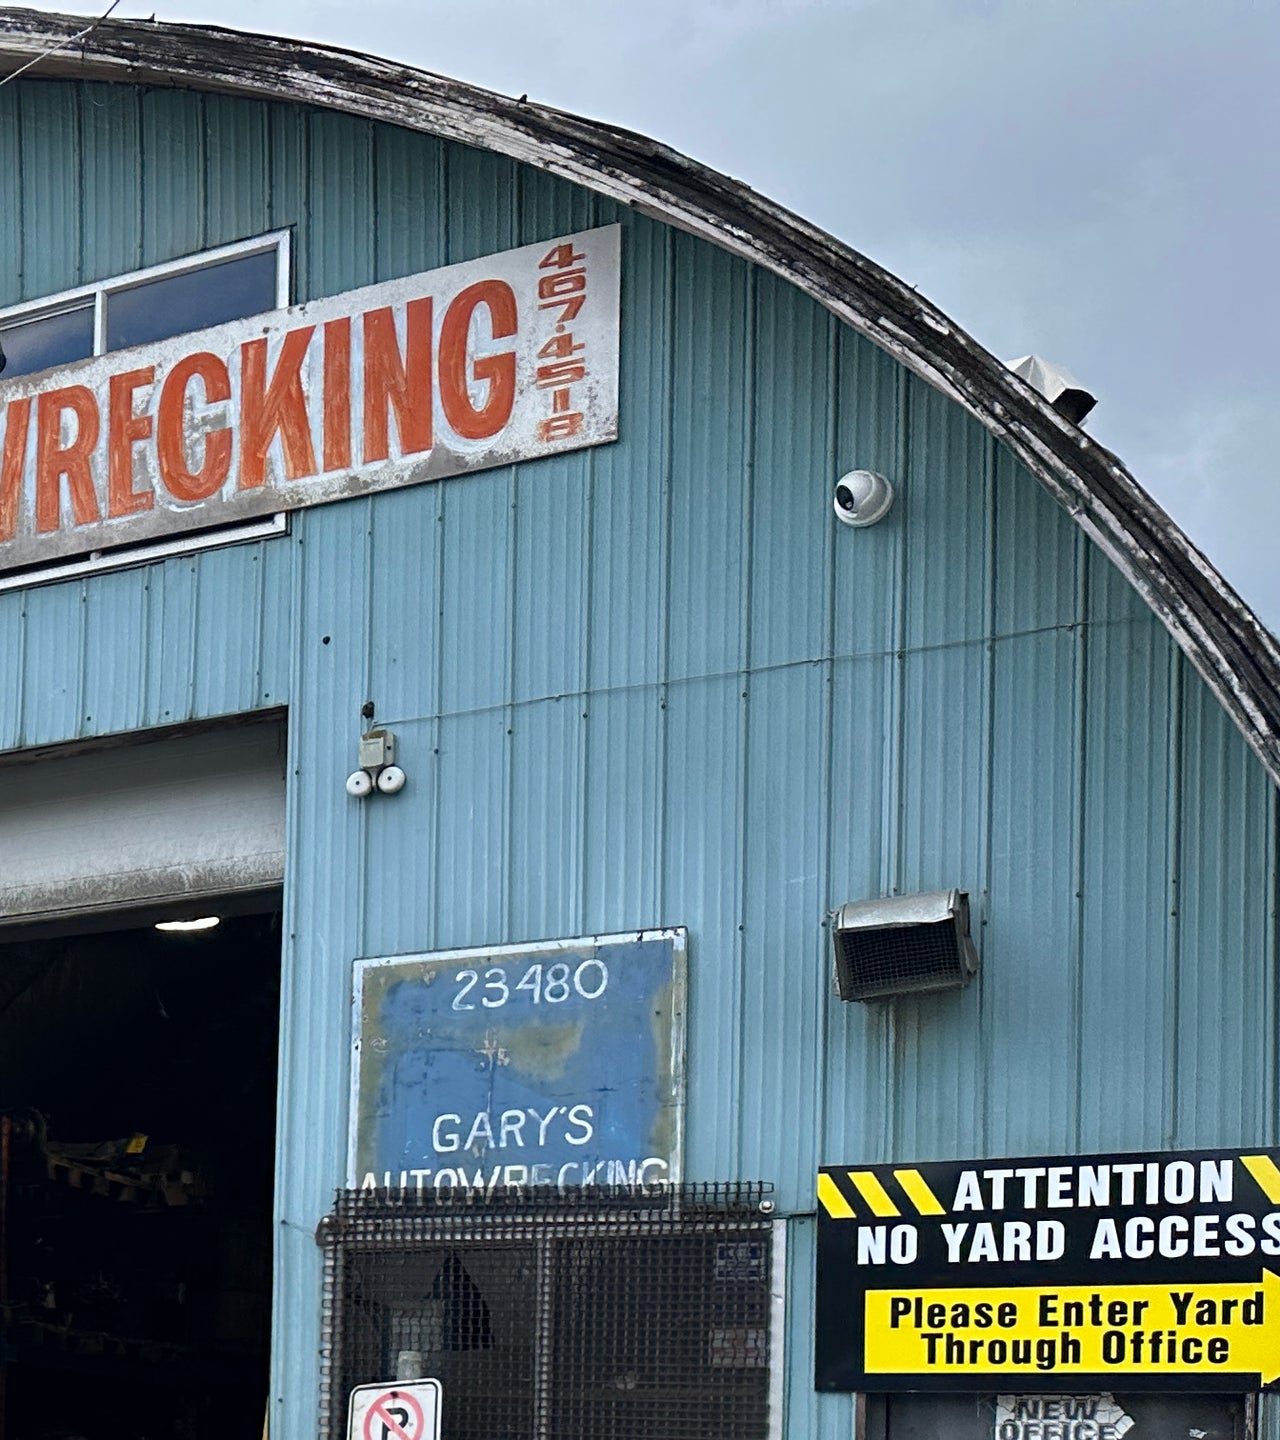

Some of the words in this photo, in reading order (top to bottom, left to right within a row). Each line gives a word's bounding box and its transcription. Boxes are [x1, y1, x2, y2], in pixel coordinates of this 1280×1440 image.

[451, 958, 609, 1011] 23480
[431, 1104, 594, 1153] GARY'S
[951, 1160, 1234, 1212] ATTENTION
[856, 1224, 919, 1266] NO
[940, 1220, 1066, 1264] YARD
[1089, 1212, 1280, 1260] ACCESS
[890, 1296, 1018, 1329] Please
[1039, 1294, 1150, 1328] Enter
[1168, 1291, 1265, 1326] Yard
[920, 1332, 1082, 1371] Through
[1102, 1330, 1230, 1364] Office
[1016, 1399, 1098, 1420] NEW
